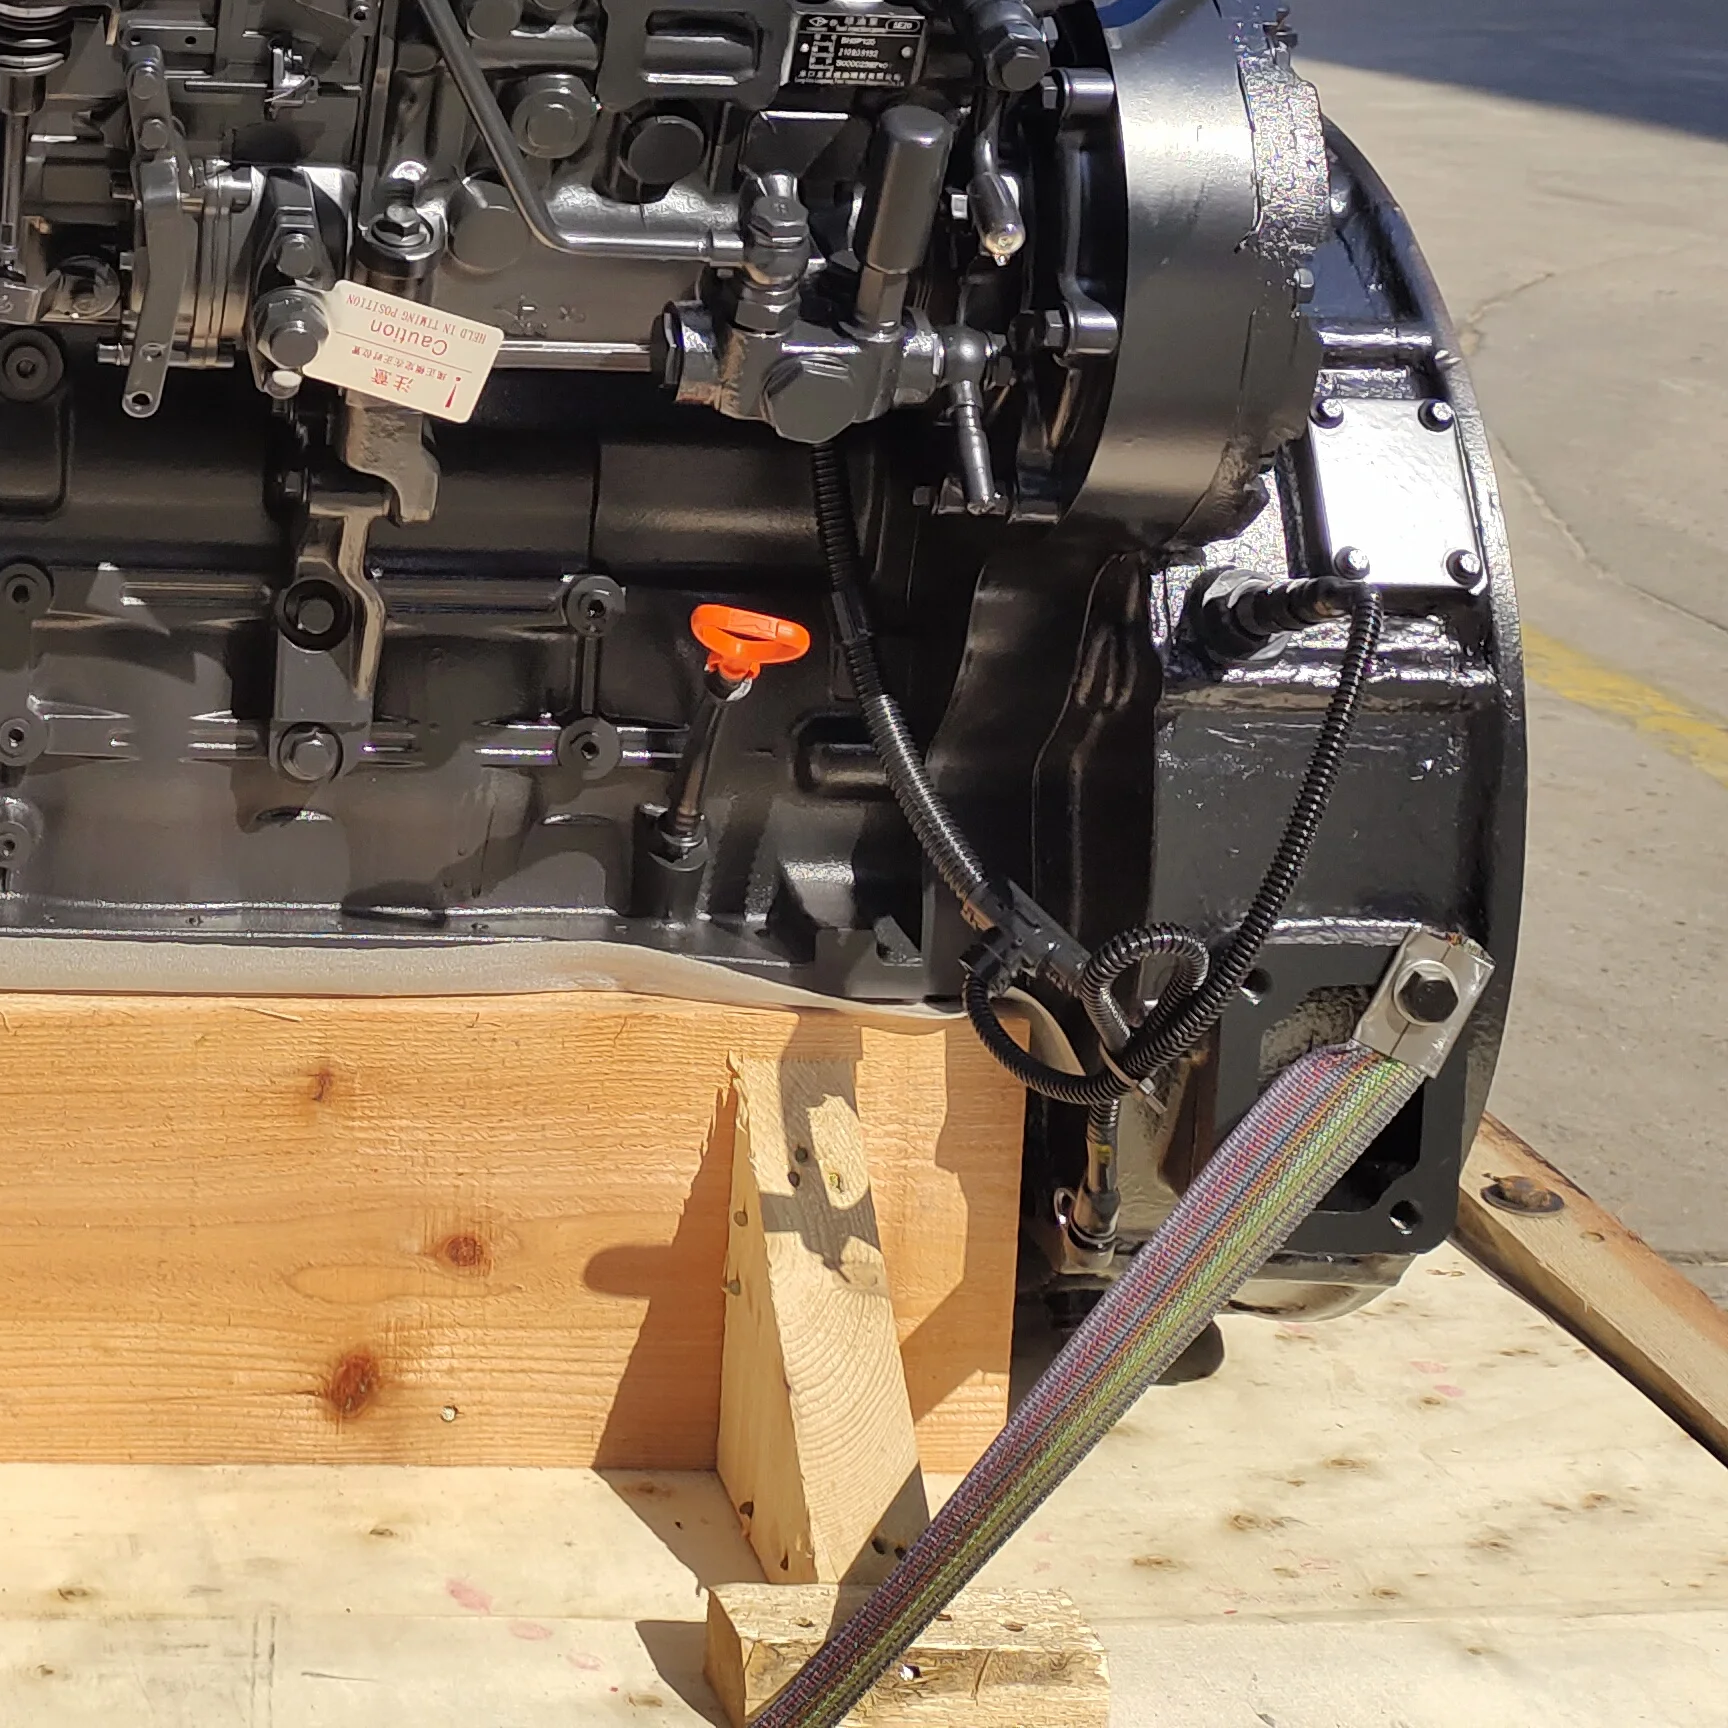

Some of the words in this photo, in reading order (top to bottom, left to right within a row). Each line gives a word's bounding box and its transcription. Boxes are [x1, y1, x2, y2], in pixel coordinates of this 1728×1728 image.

[346, 294, 397, 318] POSITION
[401, 311, 439, 331] TIMING
[442, 323, 456, 336] IN
[370, 319, 448, 356] Caution
[459, 330, 487, 345] HELD
[372, 368, 414, 393] 注意
